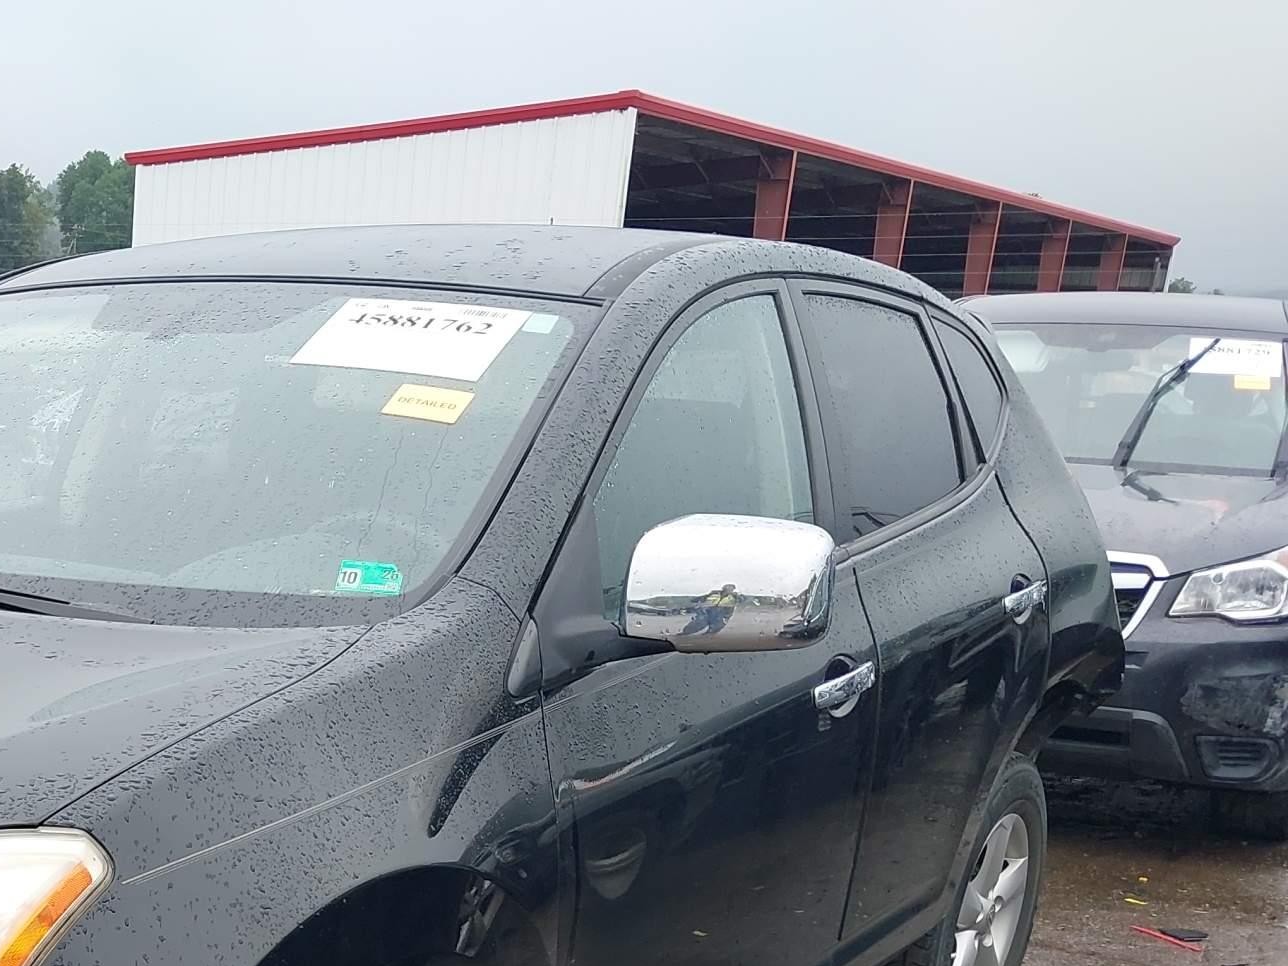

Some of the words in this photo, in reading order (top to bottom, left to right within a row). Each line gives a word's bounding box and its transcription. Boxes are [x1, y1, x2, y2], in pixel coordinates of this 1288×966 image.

[348, 313, 493, 335] 45881762
[397, 396, 457, 410] DETAILED
[341, 570, 358, 584] 10
